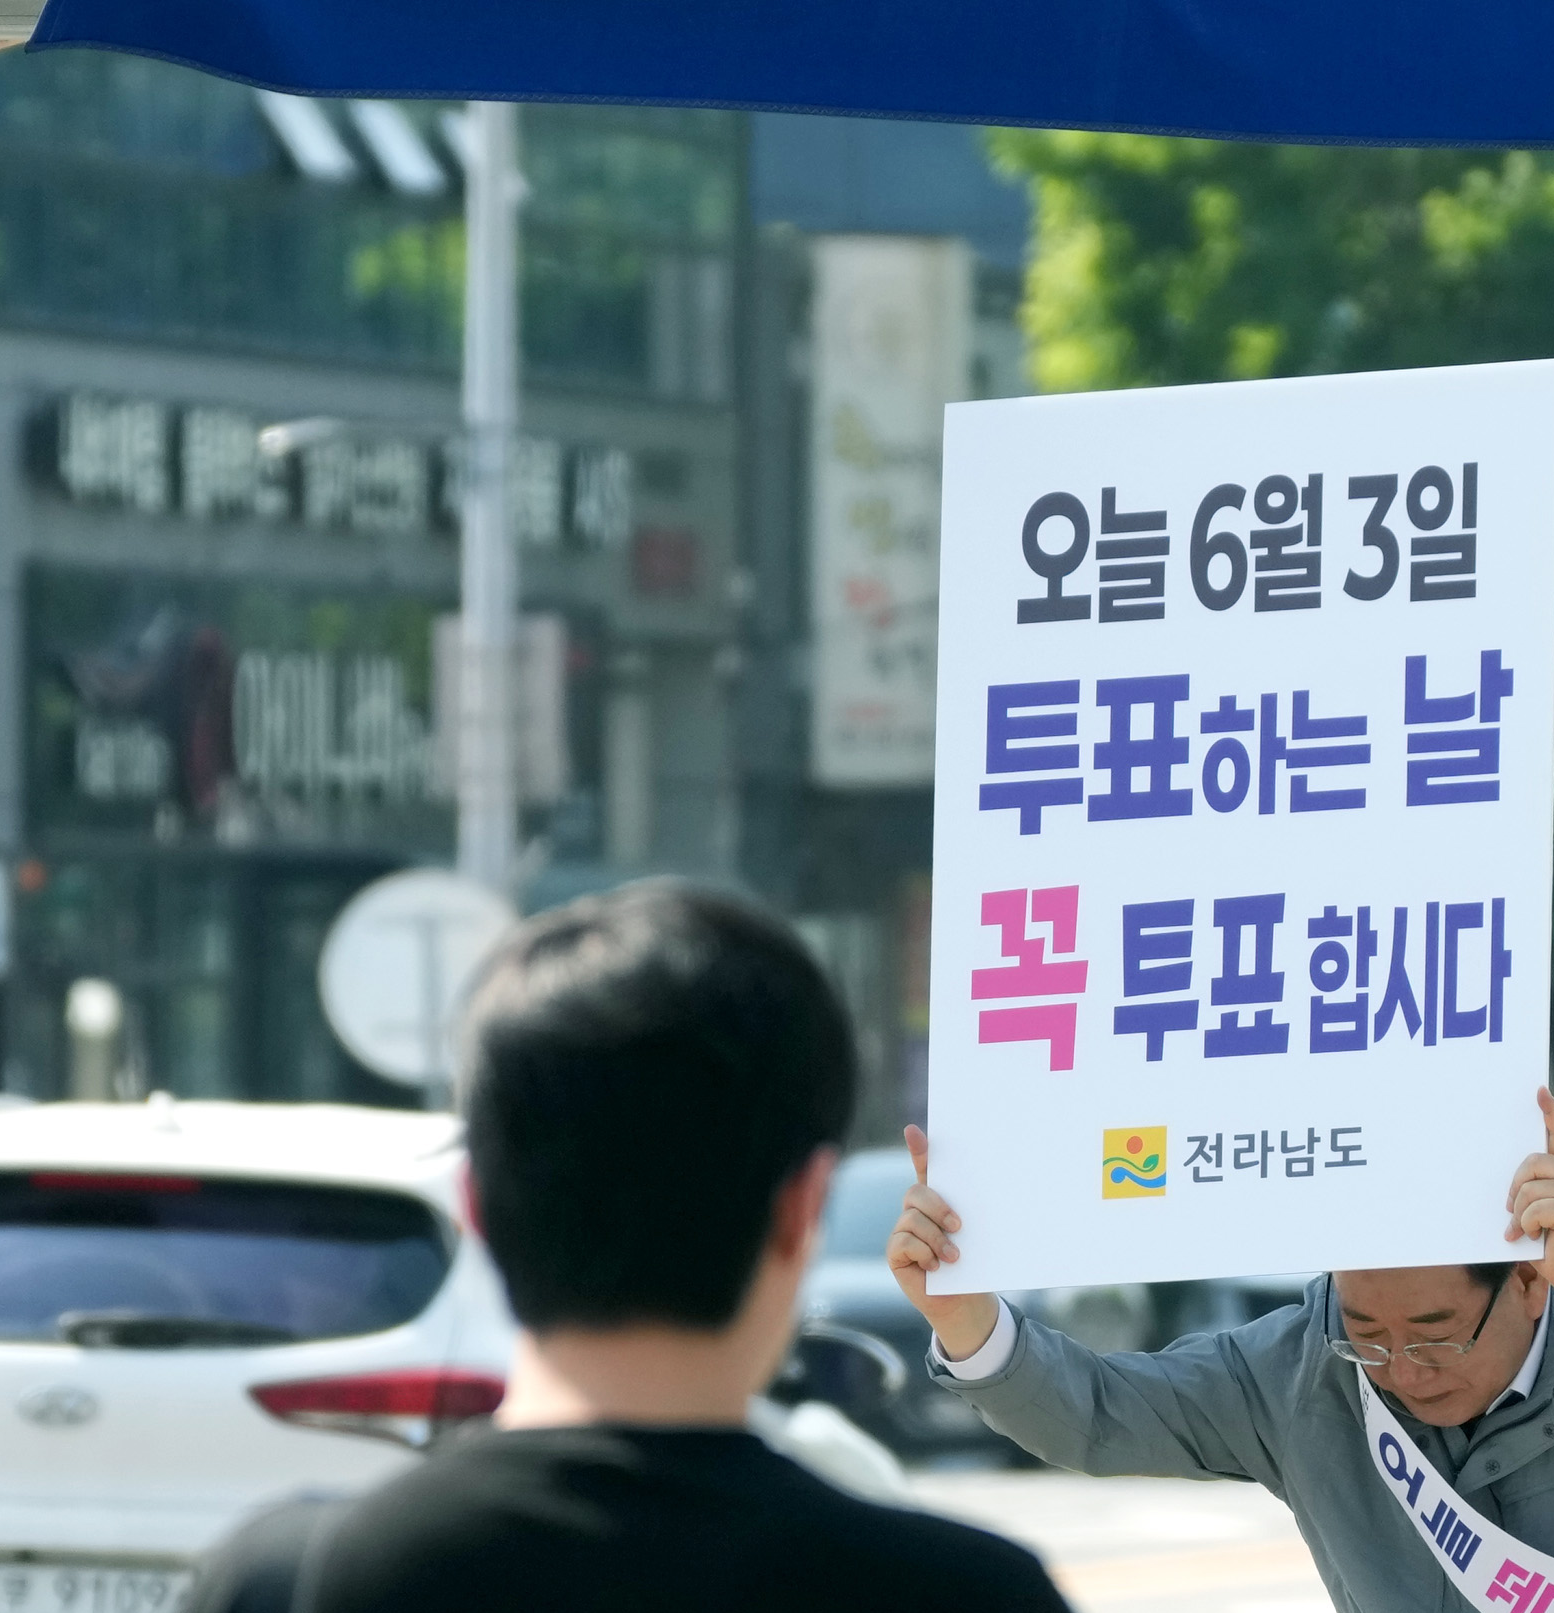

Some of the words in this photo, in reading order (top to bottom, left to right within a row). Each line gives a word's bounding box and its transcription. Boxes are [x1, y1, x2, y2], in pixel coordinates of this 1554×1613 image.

[1016, 484, 1170, 625] 오늘
[1189, 471, 1324, 615] 6월
[1343, 460, 1480, 604] 3일
[978, 672, 1372, 836] 투표하는
[1404, 648, 1515, 807] 날
[971, 884, 1089, 1072] 꼭
[1183, 1126, 1368, 1184] 전라남도
[1376, 1431, 1483, 1576] 오늘
